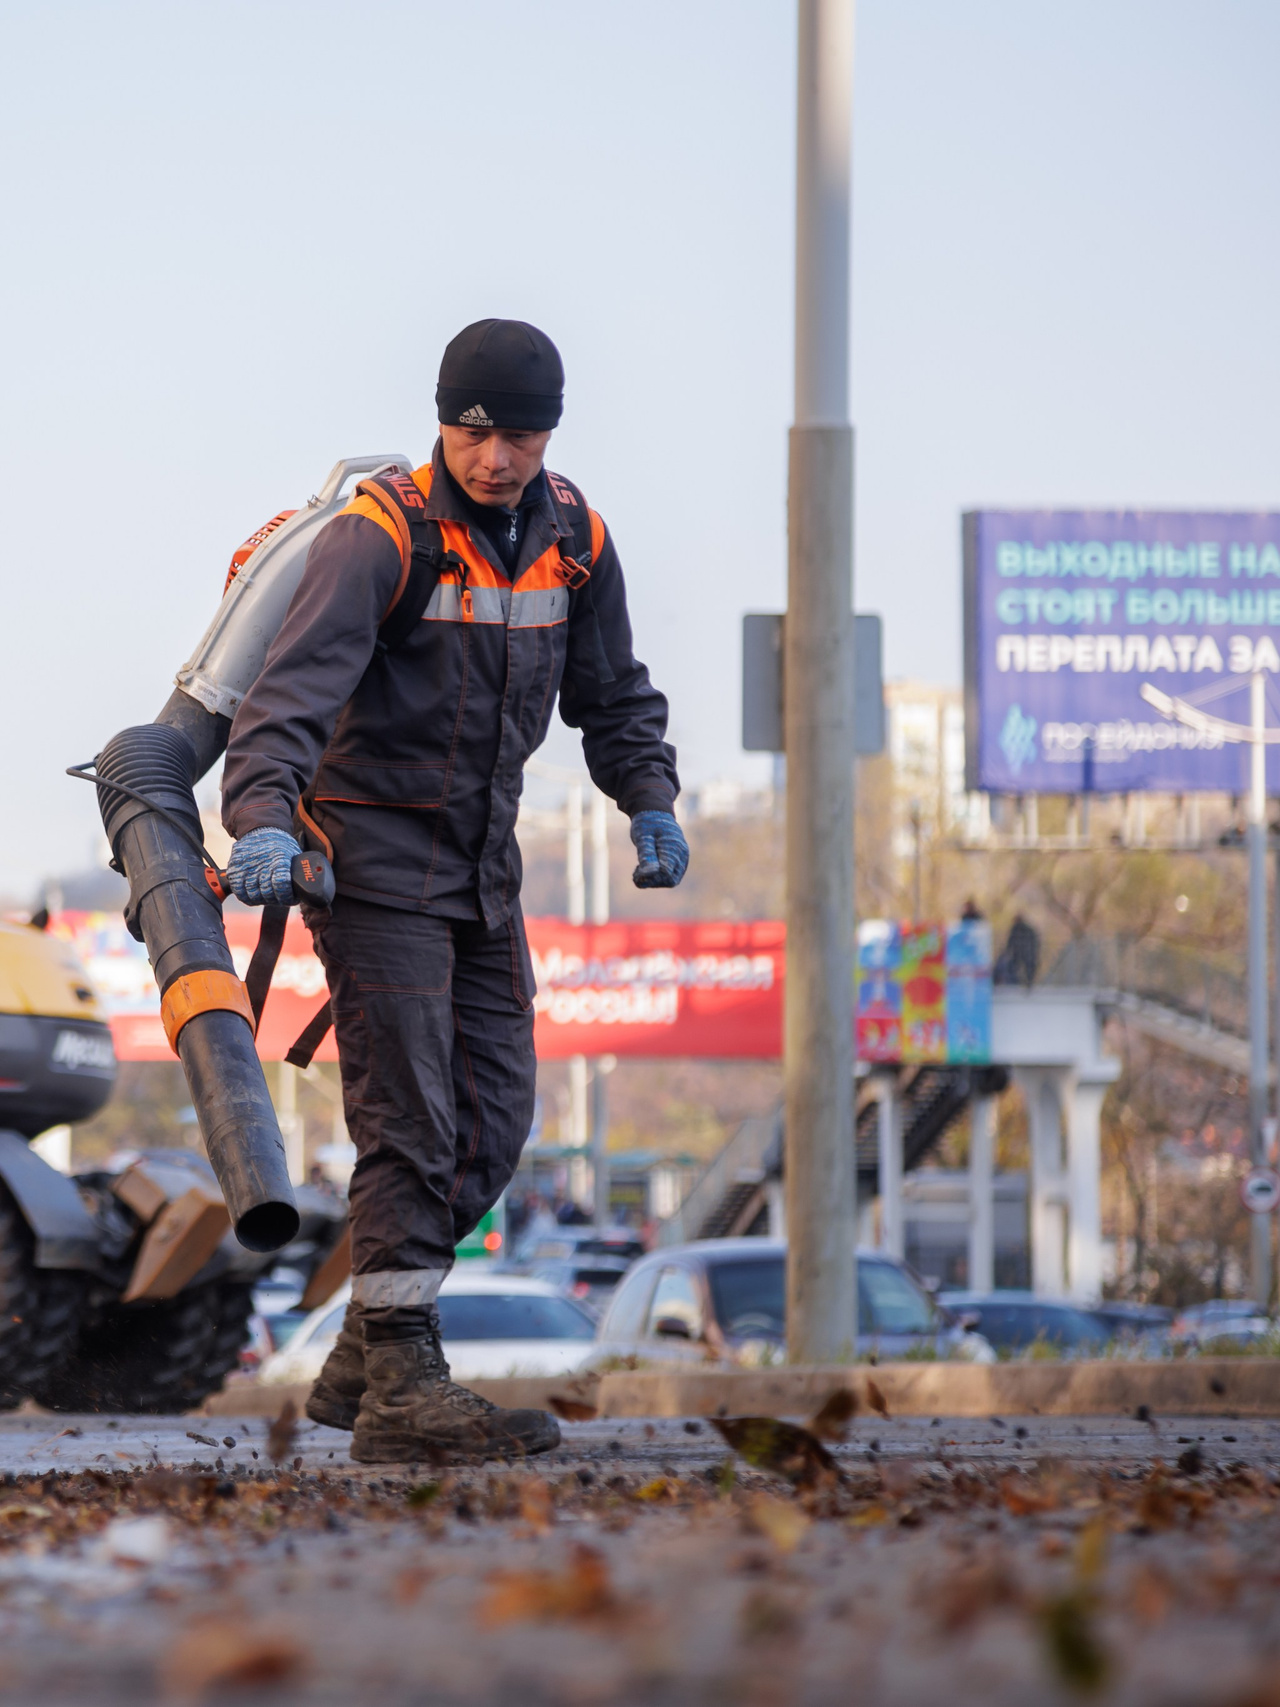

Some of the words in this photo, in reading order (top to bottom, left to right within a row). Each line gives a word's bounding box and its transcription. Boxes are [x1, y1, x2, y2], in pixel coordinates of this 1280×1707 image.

[459, 415, 494, 427] adidas
[380, 472, 425, 509] STIH
[997, 541, 1221, 582] ВЫХОДНЫЕ
[996, 588, 1118, 625] СТОЯТ
[1125, 588, 1280, 625] БОЛЬШЕ
[996, 634, 1223, 673] ПЕРЕПЛАТА
[1229, 635, 1280, 673] ЗА
[301, 860, 314, 881] STIHL
